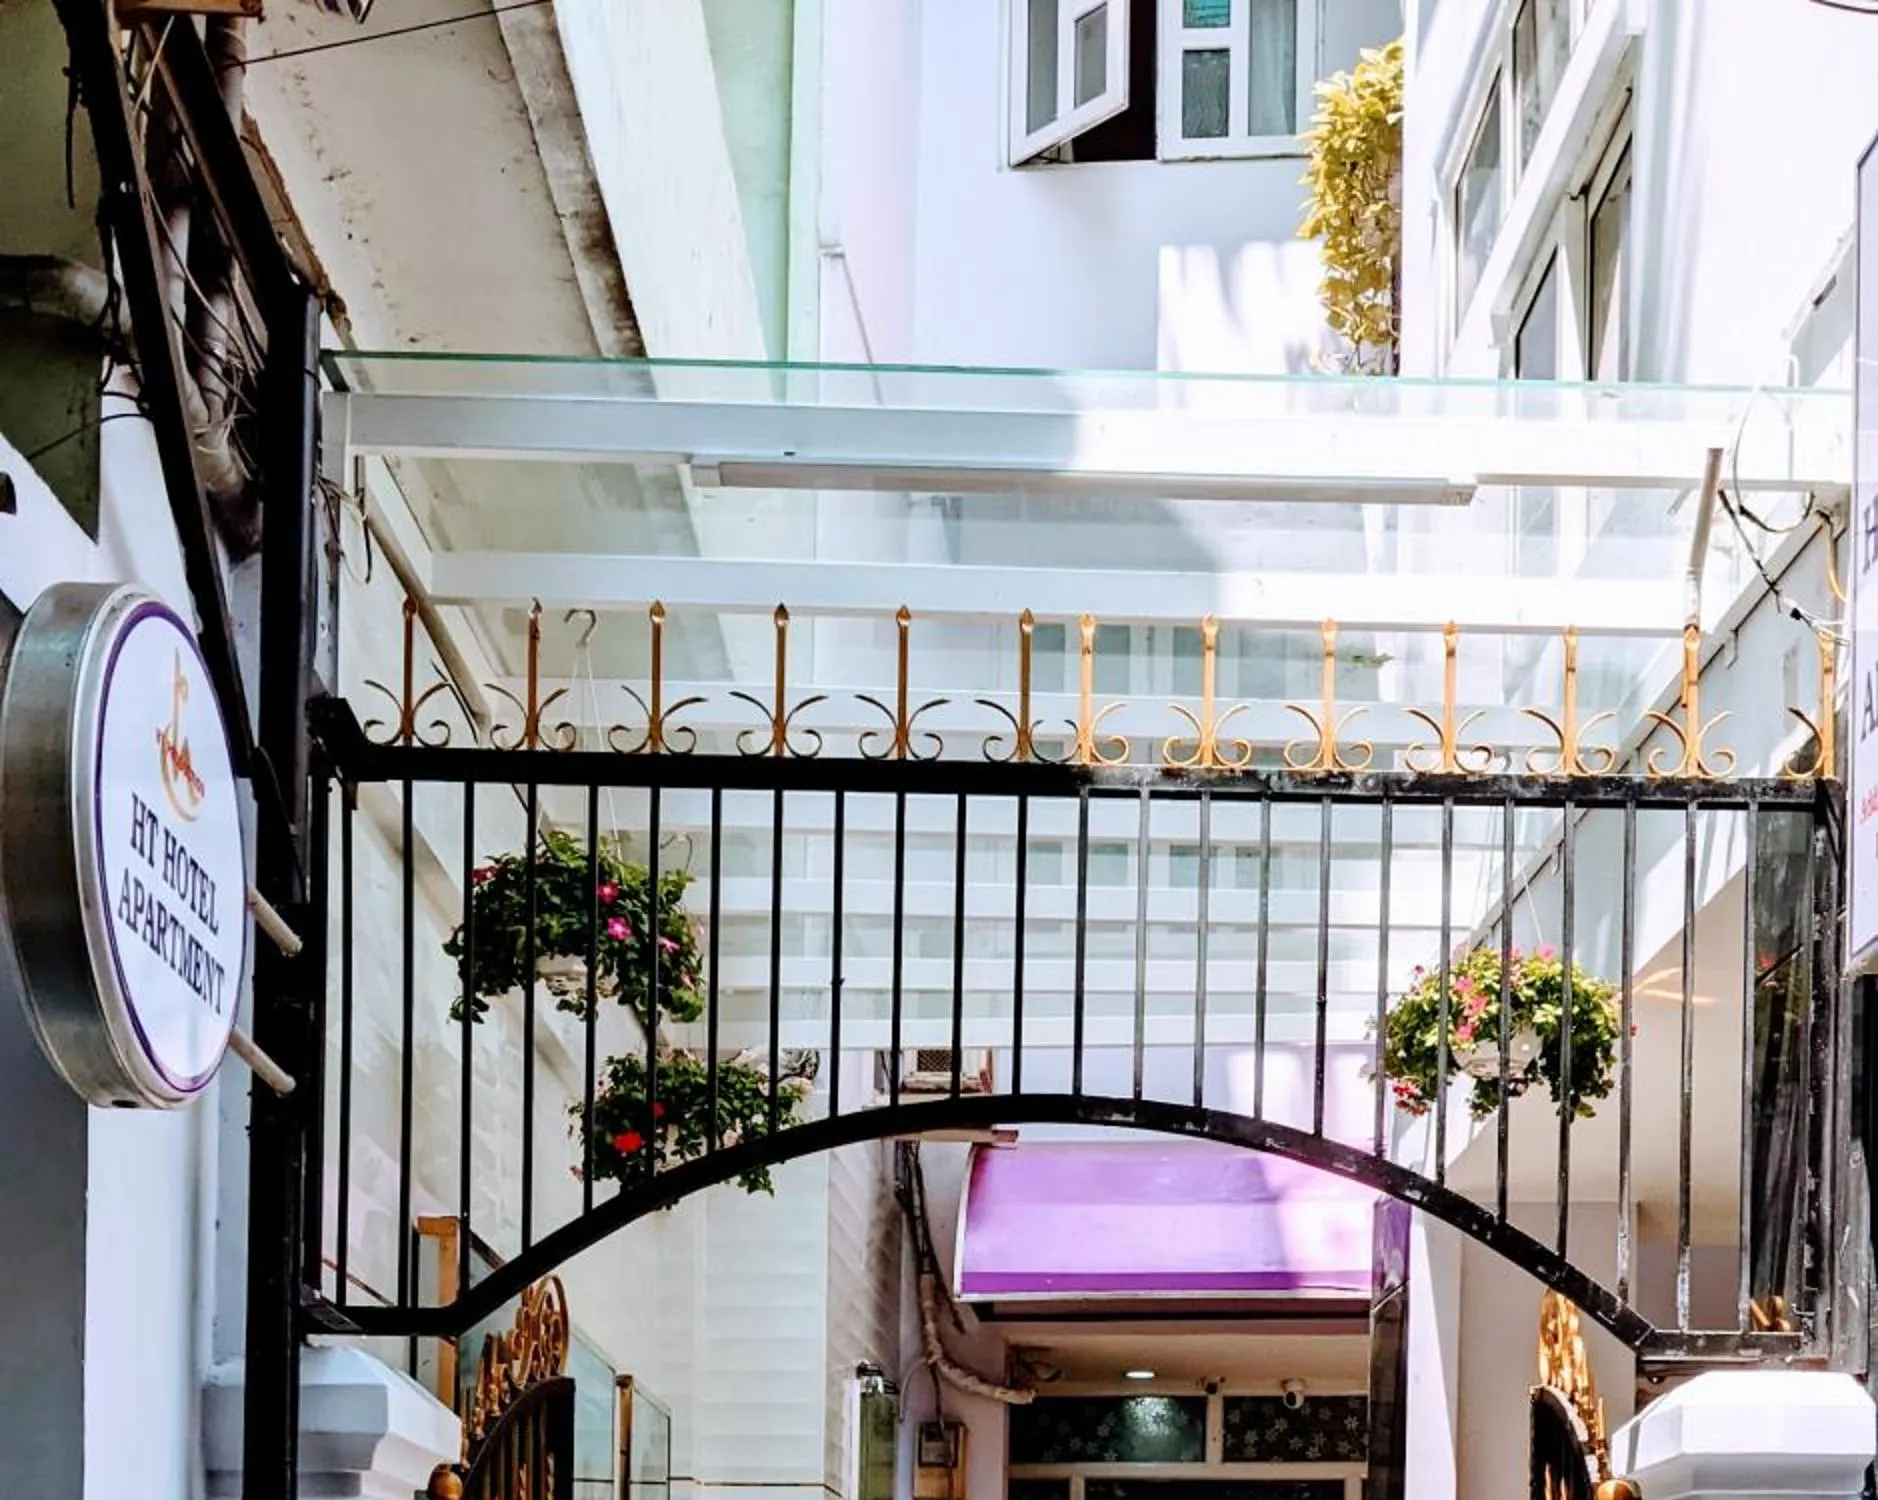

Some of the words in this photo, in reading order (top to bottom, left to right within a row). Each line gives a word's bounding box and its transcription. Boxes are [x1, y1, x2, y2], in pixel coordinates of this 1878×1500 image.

[131, 793, 158, 866] HT
[163, 825, 219, 936] HOTEL
[118, 867, 226, 1015] APARTMENT
